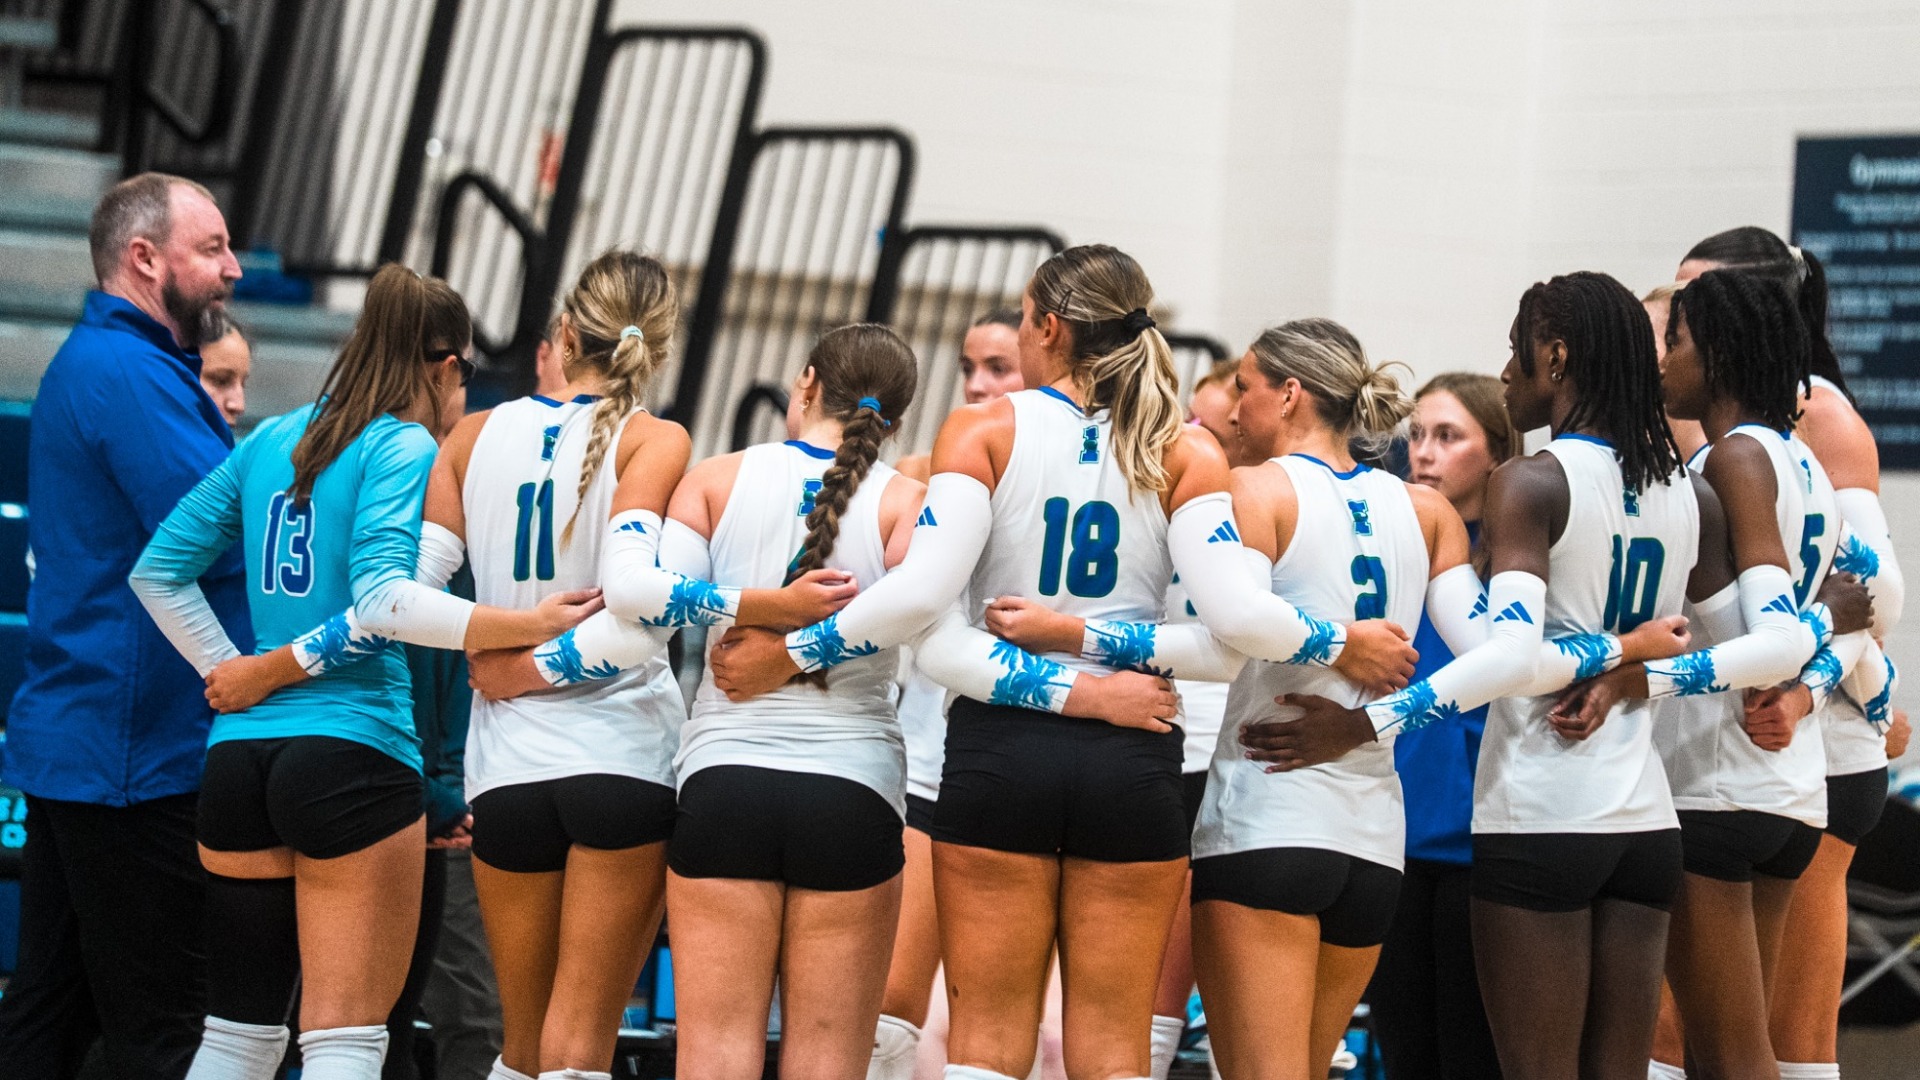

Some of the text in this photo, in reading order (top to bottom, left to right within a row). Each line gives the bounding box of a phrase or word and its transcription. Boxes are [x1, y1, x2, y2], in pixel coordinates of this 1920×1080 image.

[262, 490, 315, 597] 13
[513, 478, 555, 582] 11
[1038, 496, 1120, 598] 18
[1793, 513, 1825, 609] 5
[1350, 554, 1388, 621] 2
[1603, 533, 1666, 635] 10
